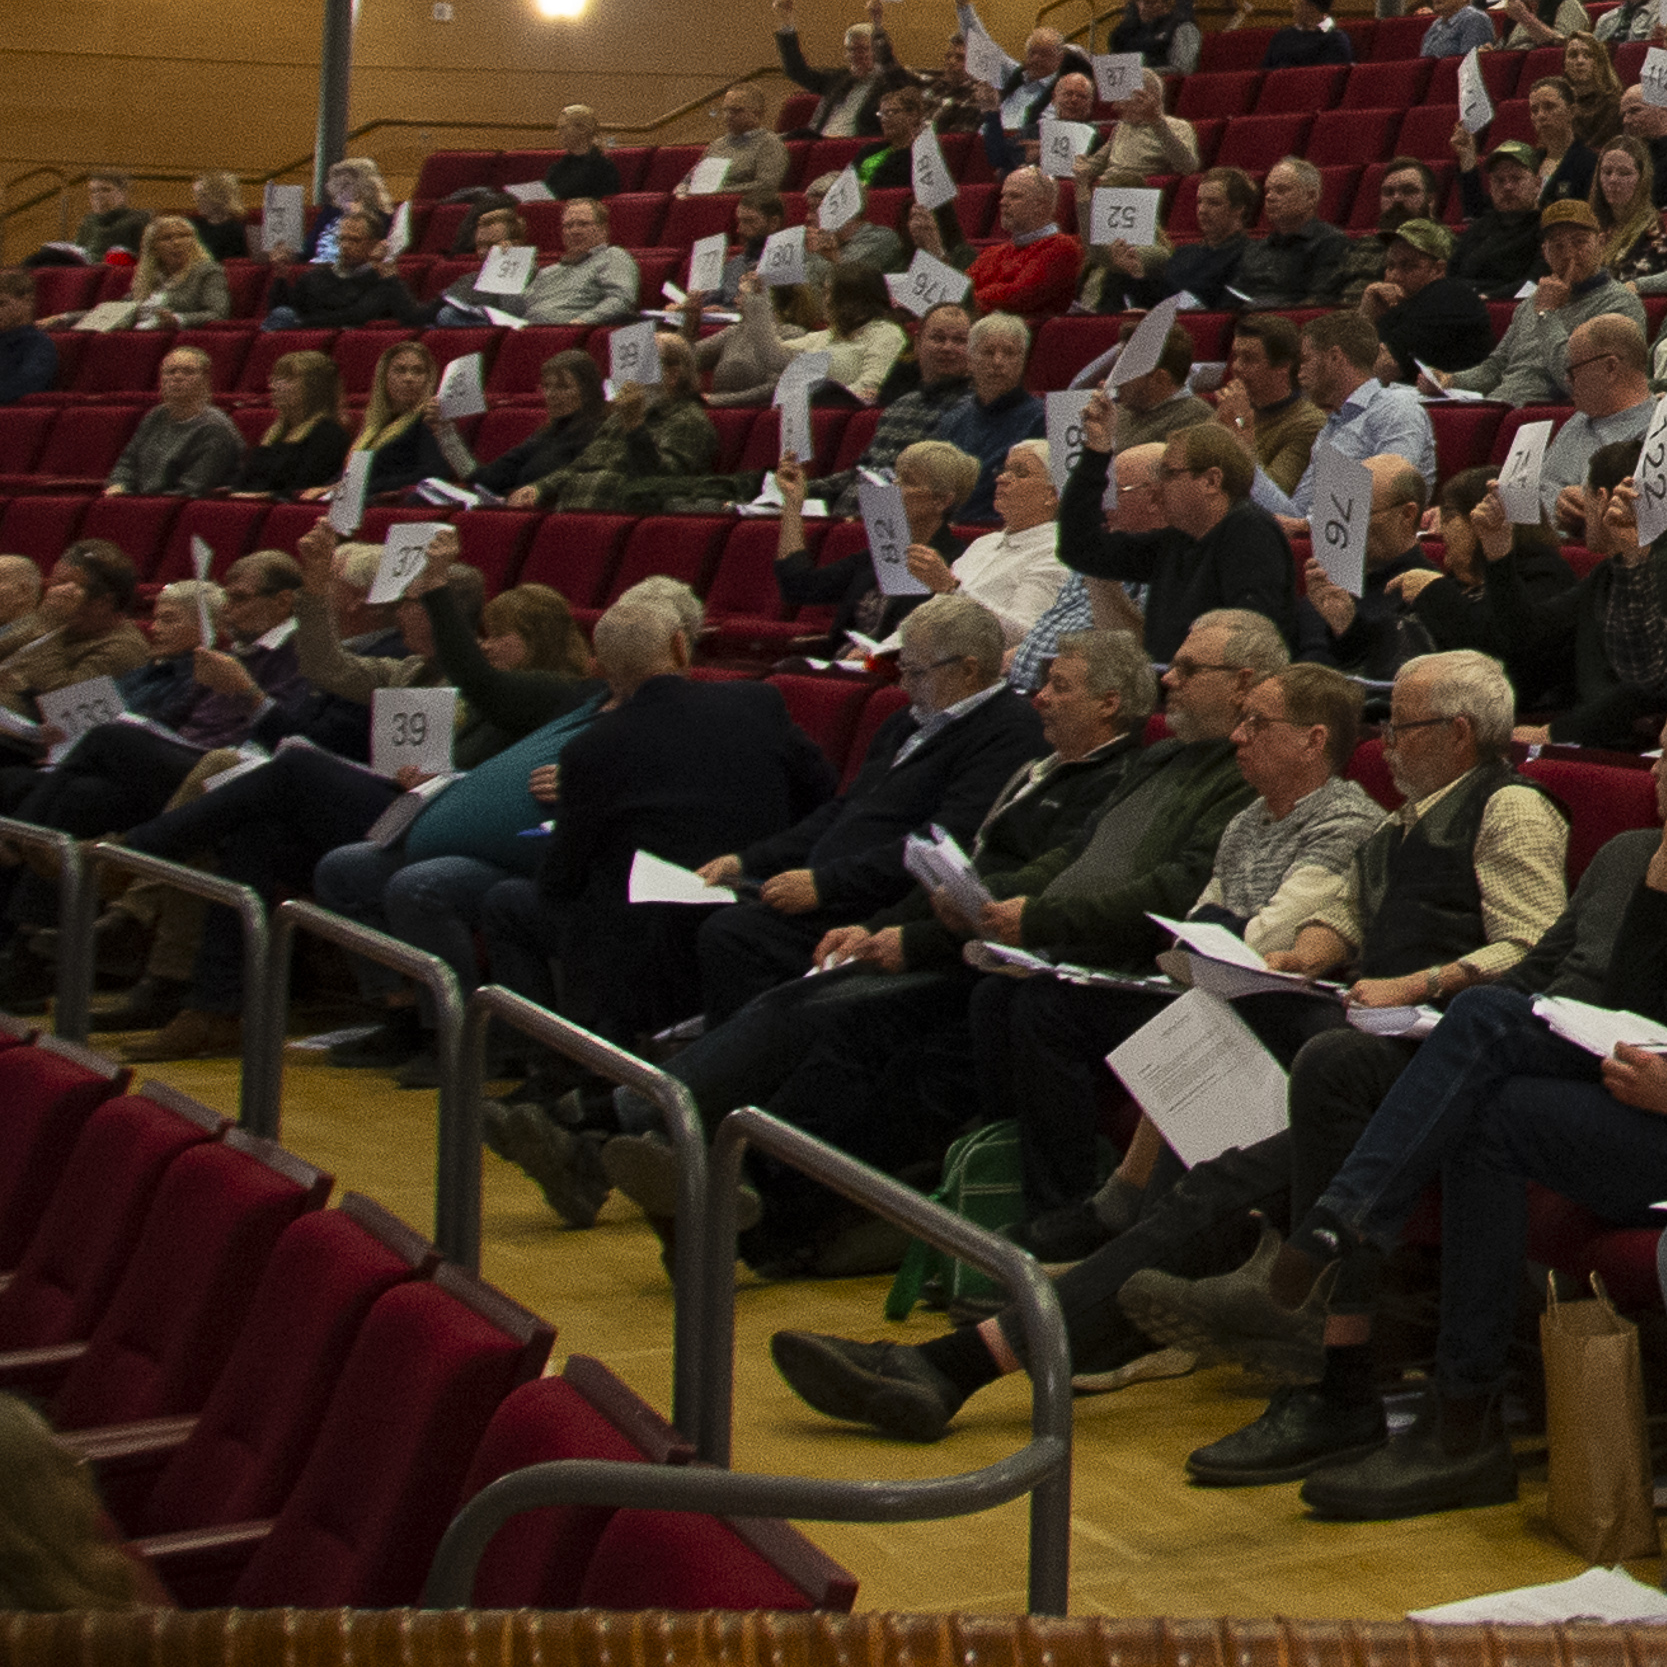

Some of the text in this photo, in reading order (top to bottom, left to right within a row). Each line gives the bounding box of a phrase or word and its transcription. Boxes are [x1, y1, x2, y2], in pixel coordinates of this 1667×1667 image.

[1107, 206, 1136, 229] 52
[1325, 493, 1354, 550] 76
[390, 713, 424, 748] 39
